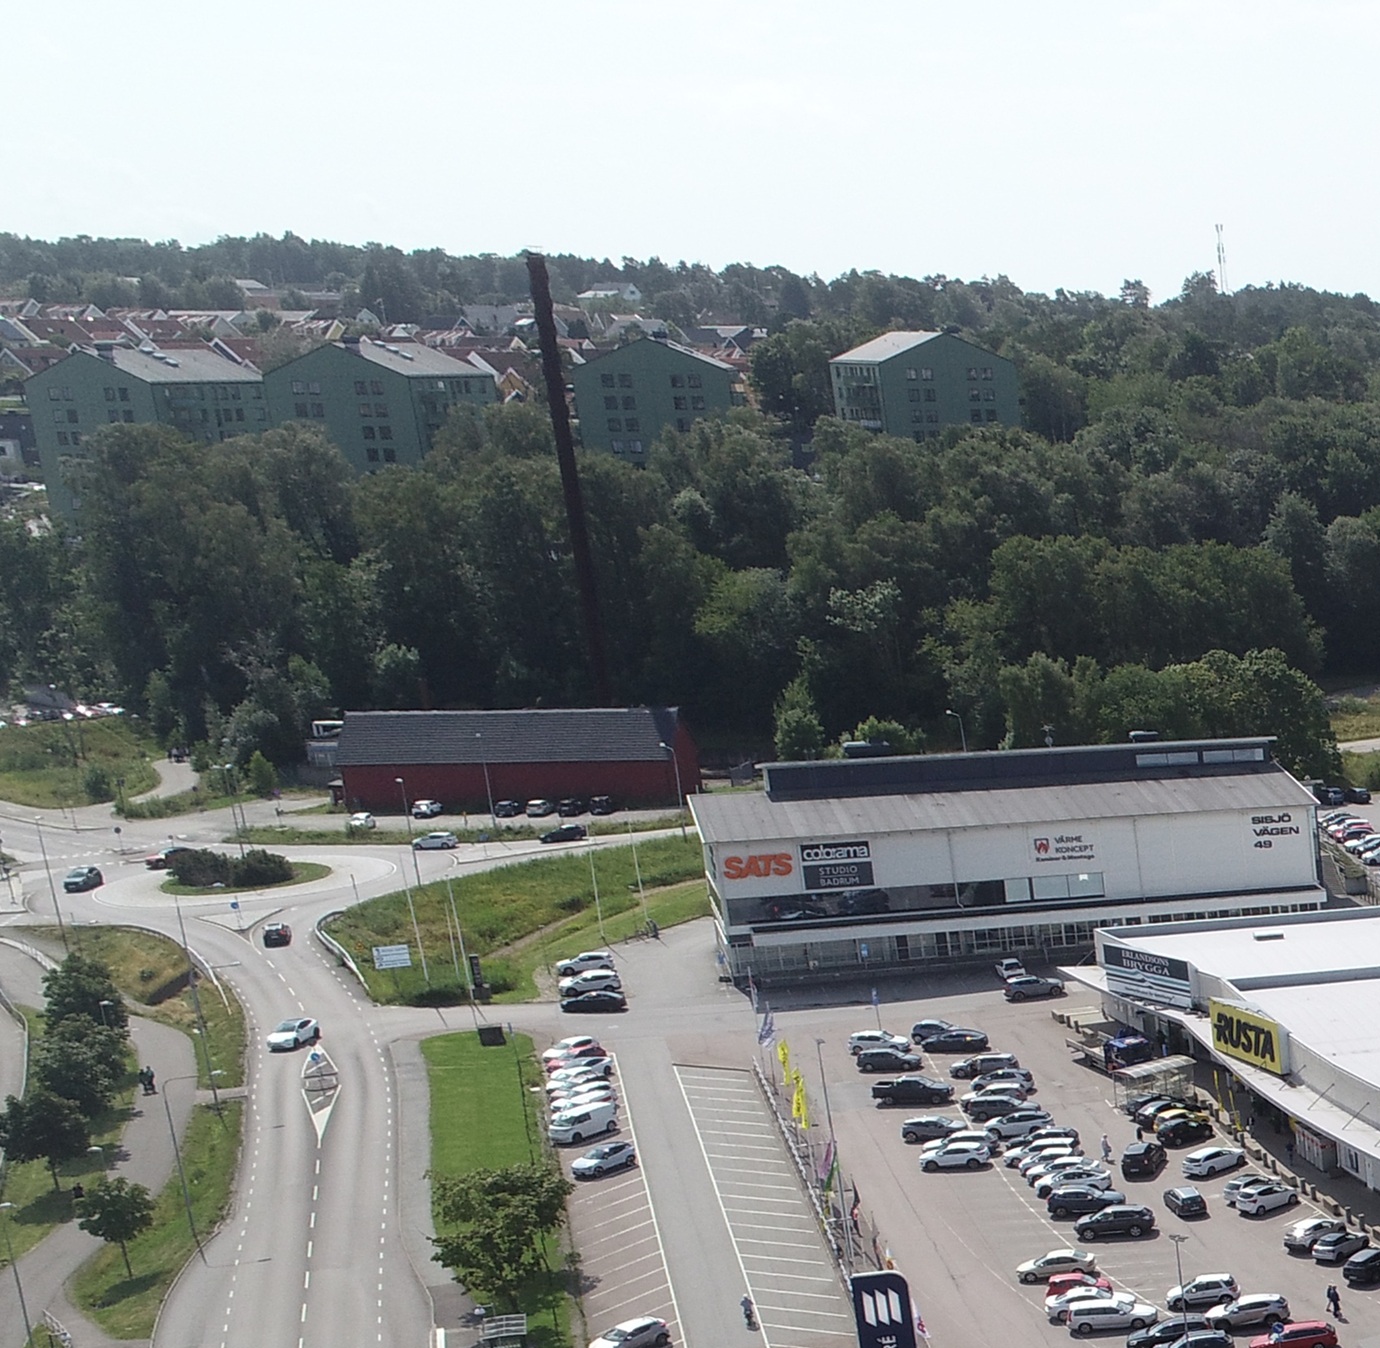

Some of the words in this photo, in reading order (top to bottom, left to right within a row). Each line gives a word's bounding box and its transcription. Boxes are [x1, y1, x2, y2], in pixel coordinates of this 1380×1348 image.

[1251, 813, 1292, 825] SISJÖ
[1252, 825, 1300, 837] VÄGEN
[1054, 835, 1083, 844] VÄRME
[1254, 840, 1273, 849] 49
[803, 844, 869, 861] colorama
[1055, 844, 1094, 853] KONCEPT
[723, 853, 793, 880] SATS
[819, 866, 858, 876] STUDIO
[820, 876, 860, 887] BADRUM
[1122, 958, 1171, 977] BRYGGA
[1214, 1012, 1276, 1063] RUSTA
